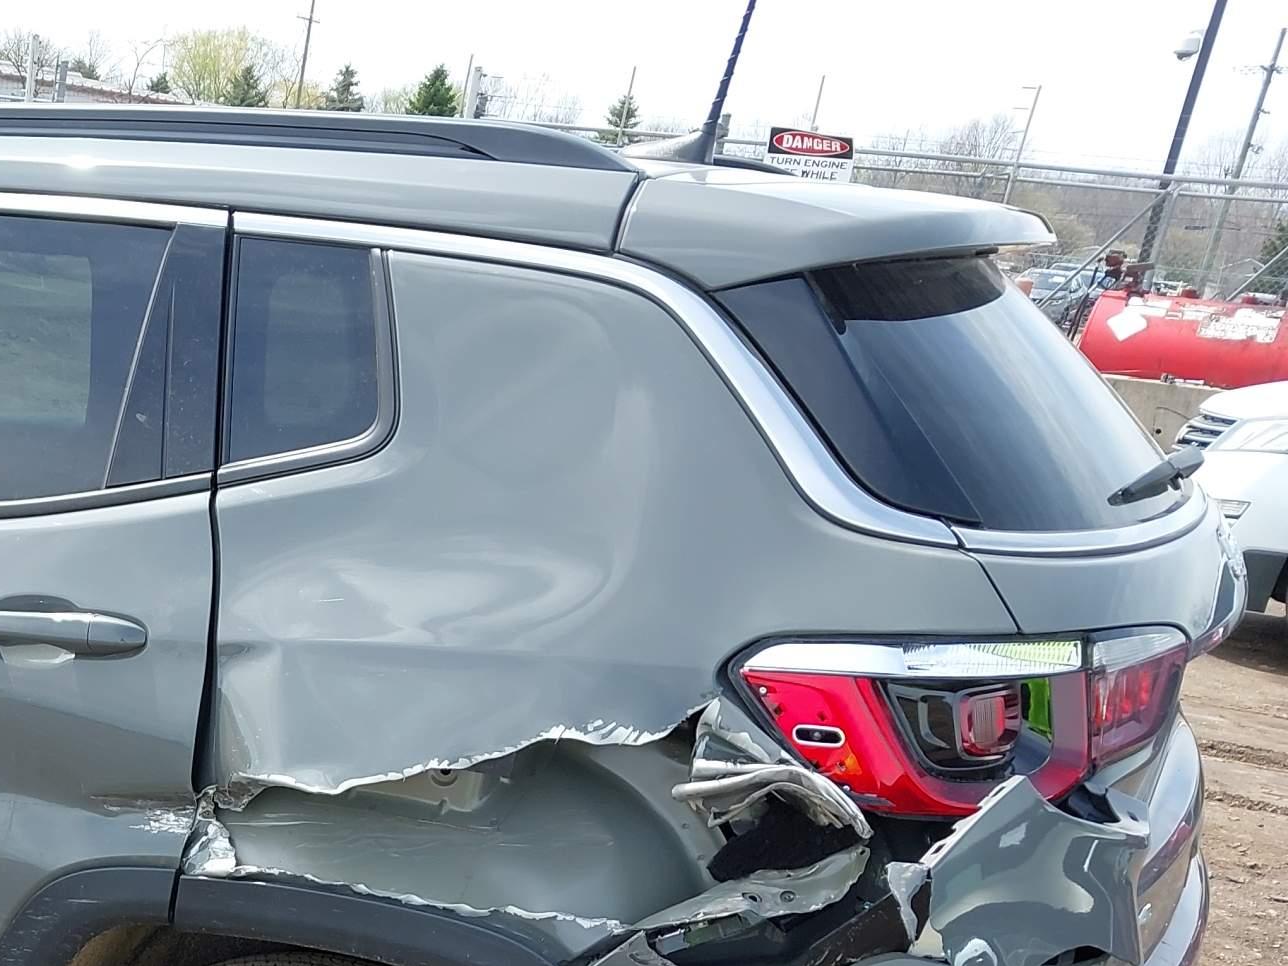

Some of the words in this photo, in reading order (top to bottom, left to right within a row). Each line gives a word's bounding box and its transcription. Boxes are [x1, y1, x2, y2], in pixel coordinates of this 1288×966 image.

[782, 134, 841, 152] DANGER
[769, 156, 801, 166] TURN
[804, 159, 848, 170] ENGINE
[800, 169, 838, 181] WHILE
